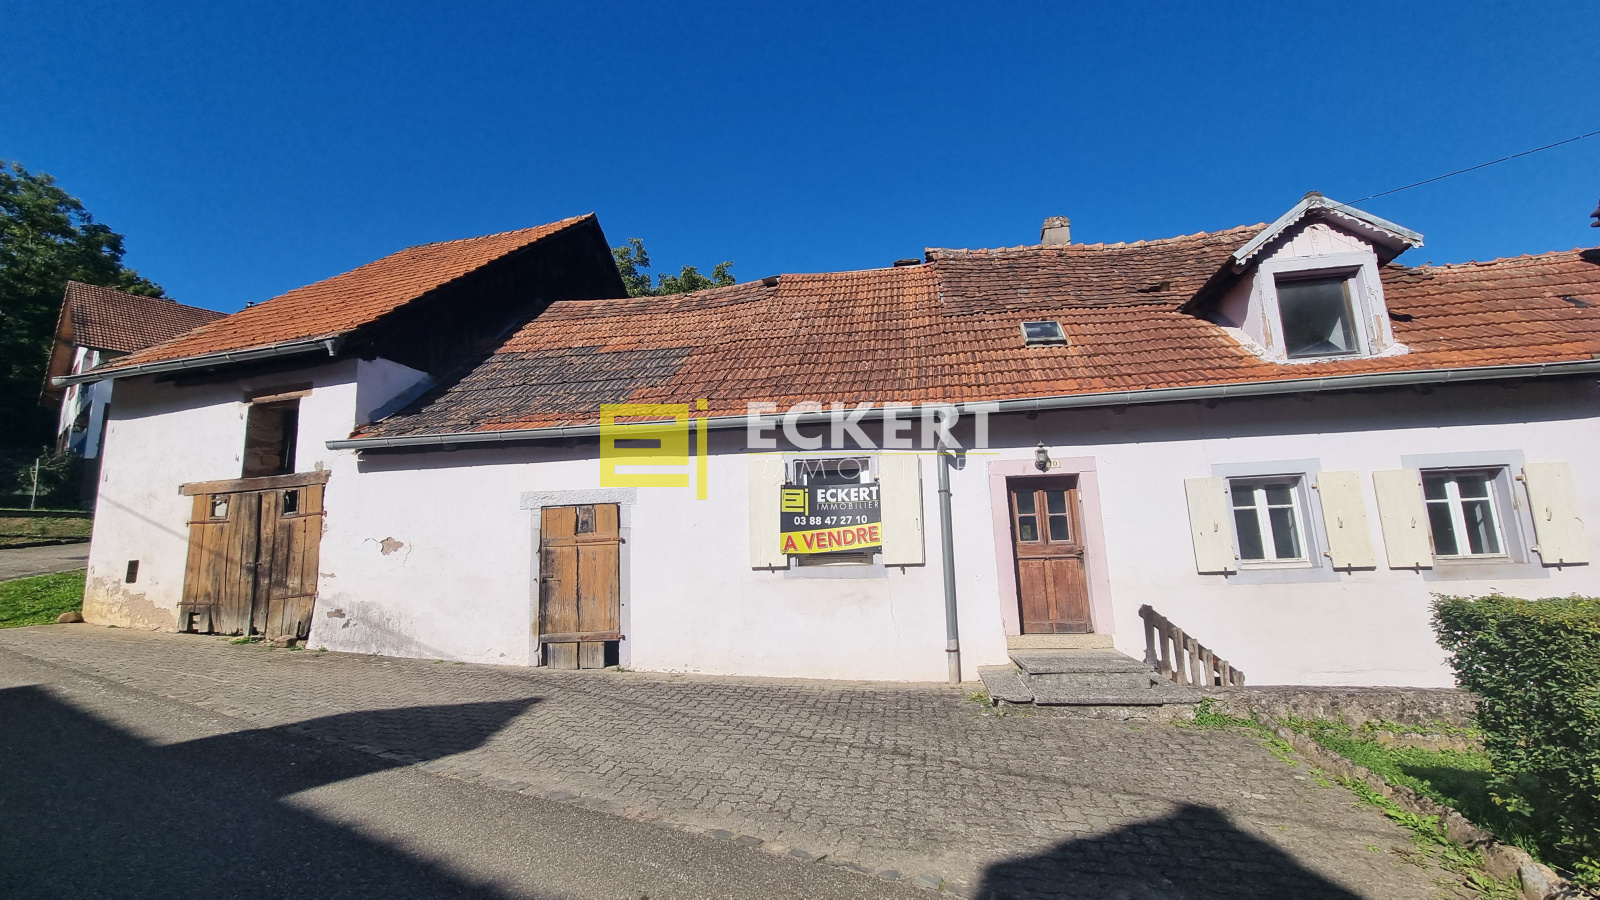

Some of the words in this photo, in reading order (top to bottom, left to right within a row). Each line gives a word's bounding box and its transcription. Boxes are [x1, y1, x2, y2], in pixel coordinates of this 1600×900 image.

[817, 487, 879, 502] ECKERT
[817, 501, 880, 510] IMMOBILIER
[794, 516, 807, 525] 03
[809, 516, 822, 525] 88
[824, 516, 838, 525] 47
[840, 515, 853, 525] 27
[855, 515, 868, 524] 10
[784, 534, 799, 552] A
[802, 525, 880, 550] VENDRE
